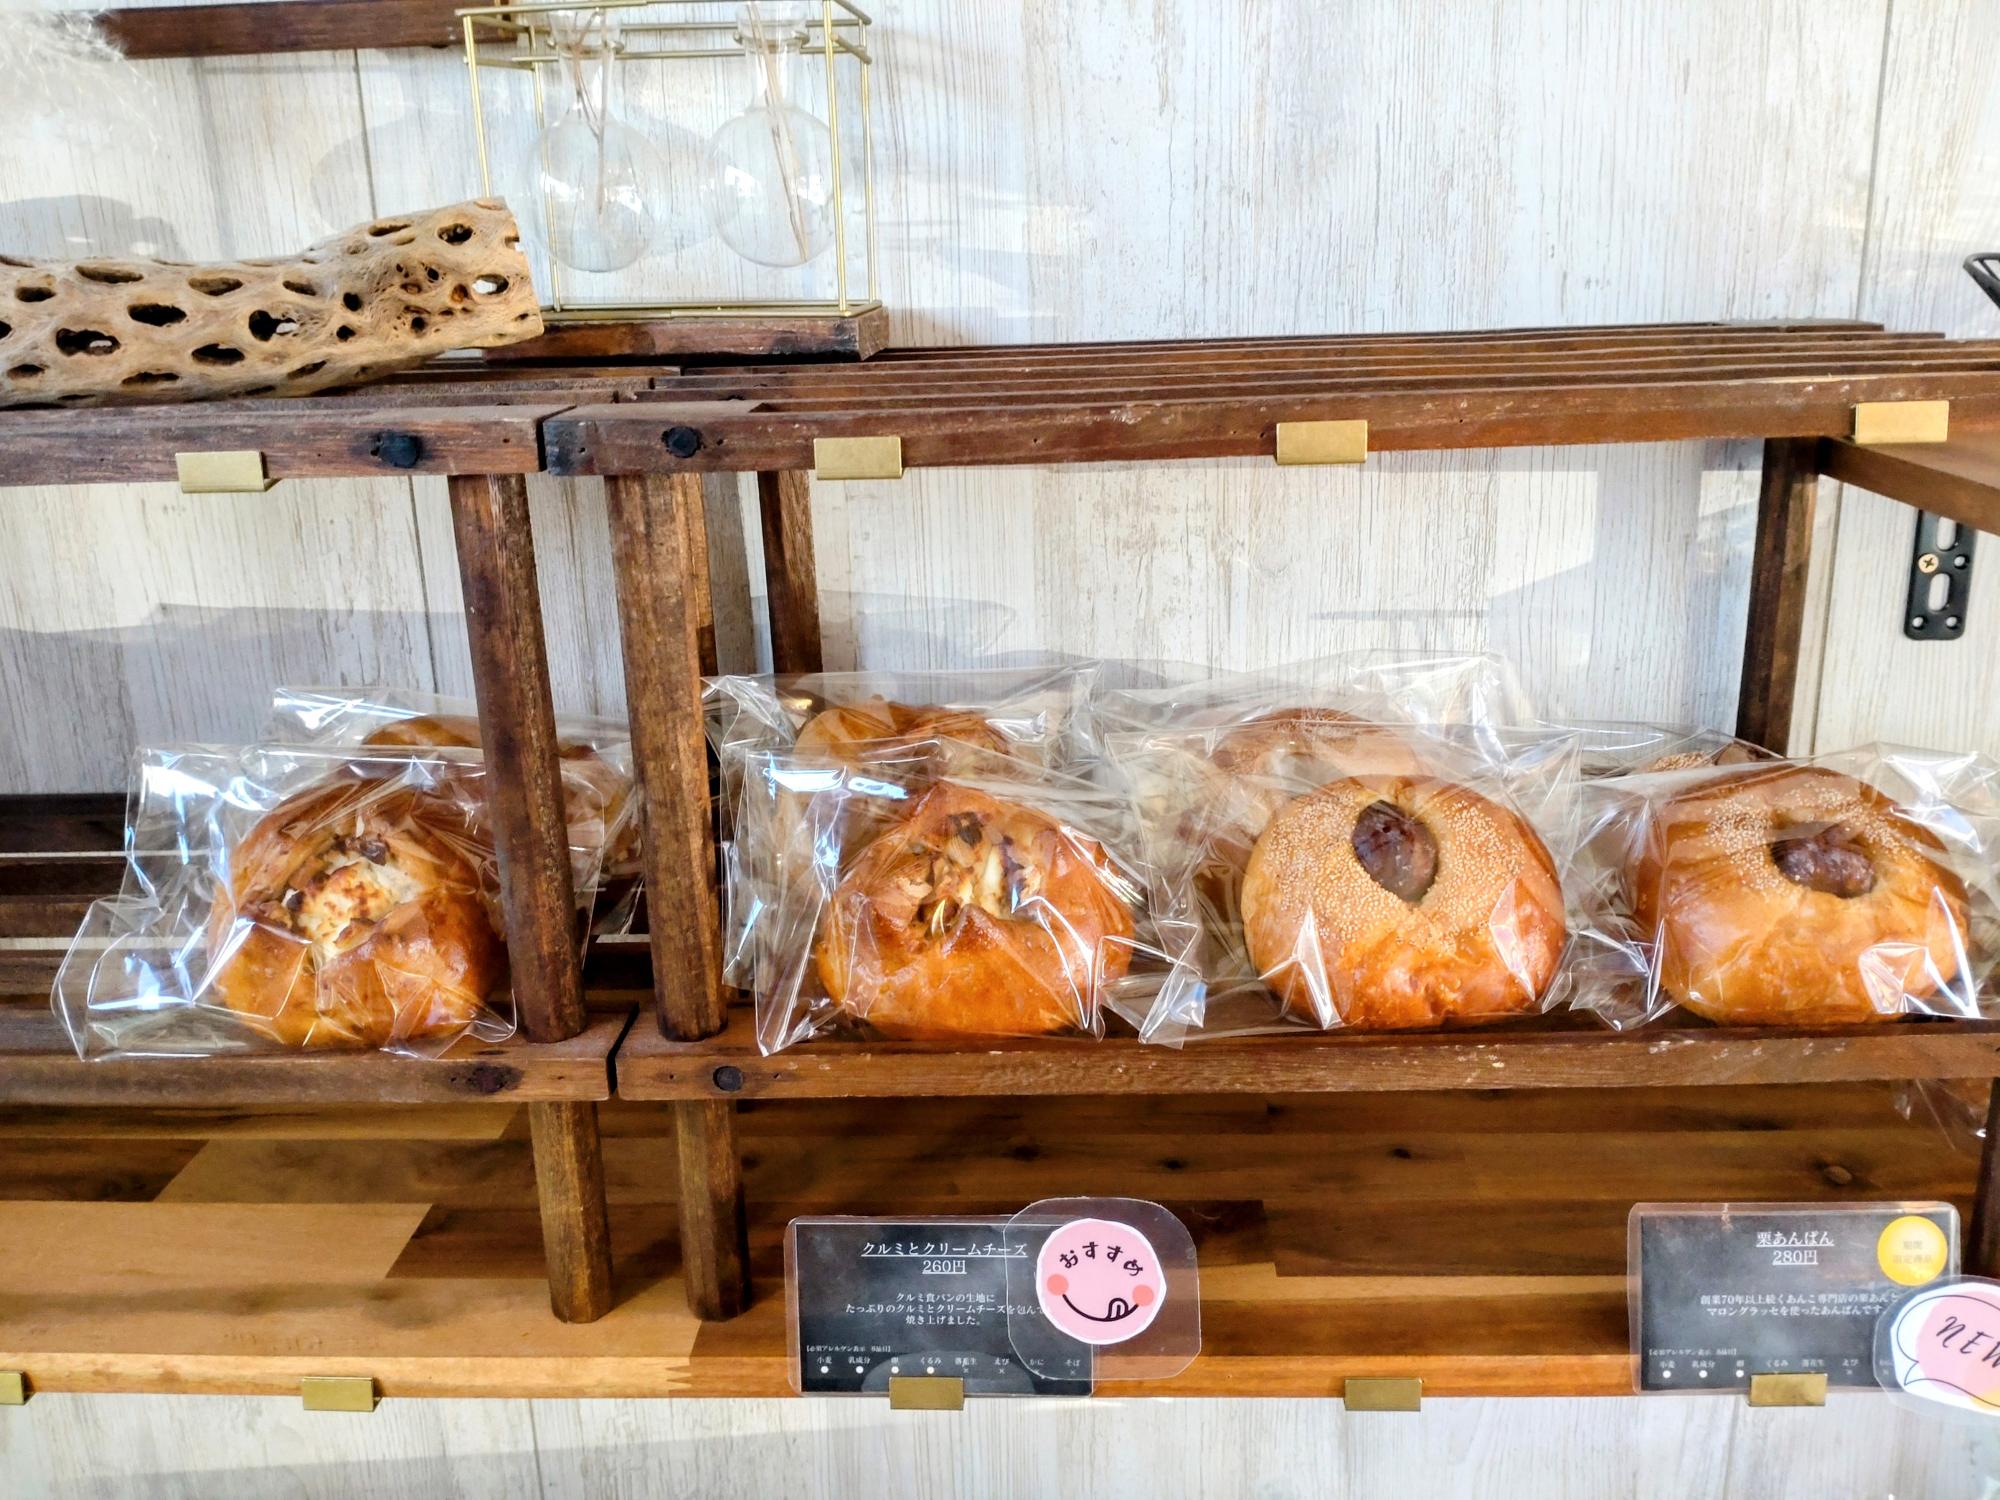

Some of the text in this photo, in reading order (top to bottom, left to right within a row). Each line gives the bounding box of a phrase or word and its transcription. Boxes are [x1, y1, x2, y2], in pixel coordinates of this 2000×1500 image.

[861, 1242, 1028, 1256] クルミとクリームチーズ
[1059, 1241, 1144, 1277] おすすめ
[1772, 1249, 1819, 1265] 280円
[922, 1259, 967, 1274] 260円
[895, 1292, 996, 1303] クルミ食パンの生地に
[905, 1315, 982, 1326] 焼き上げました。
[919, 1357, 942, 1366] くるみ
